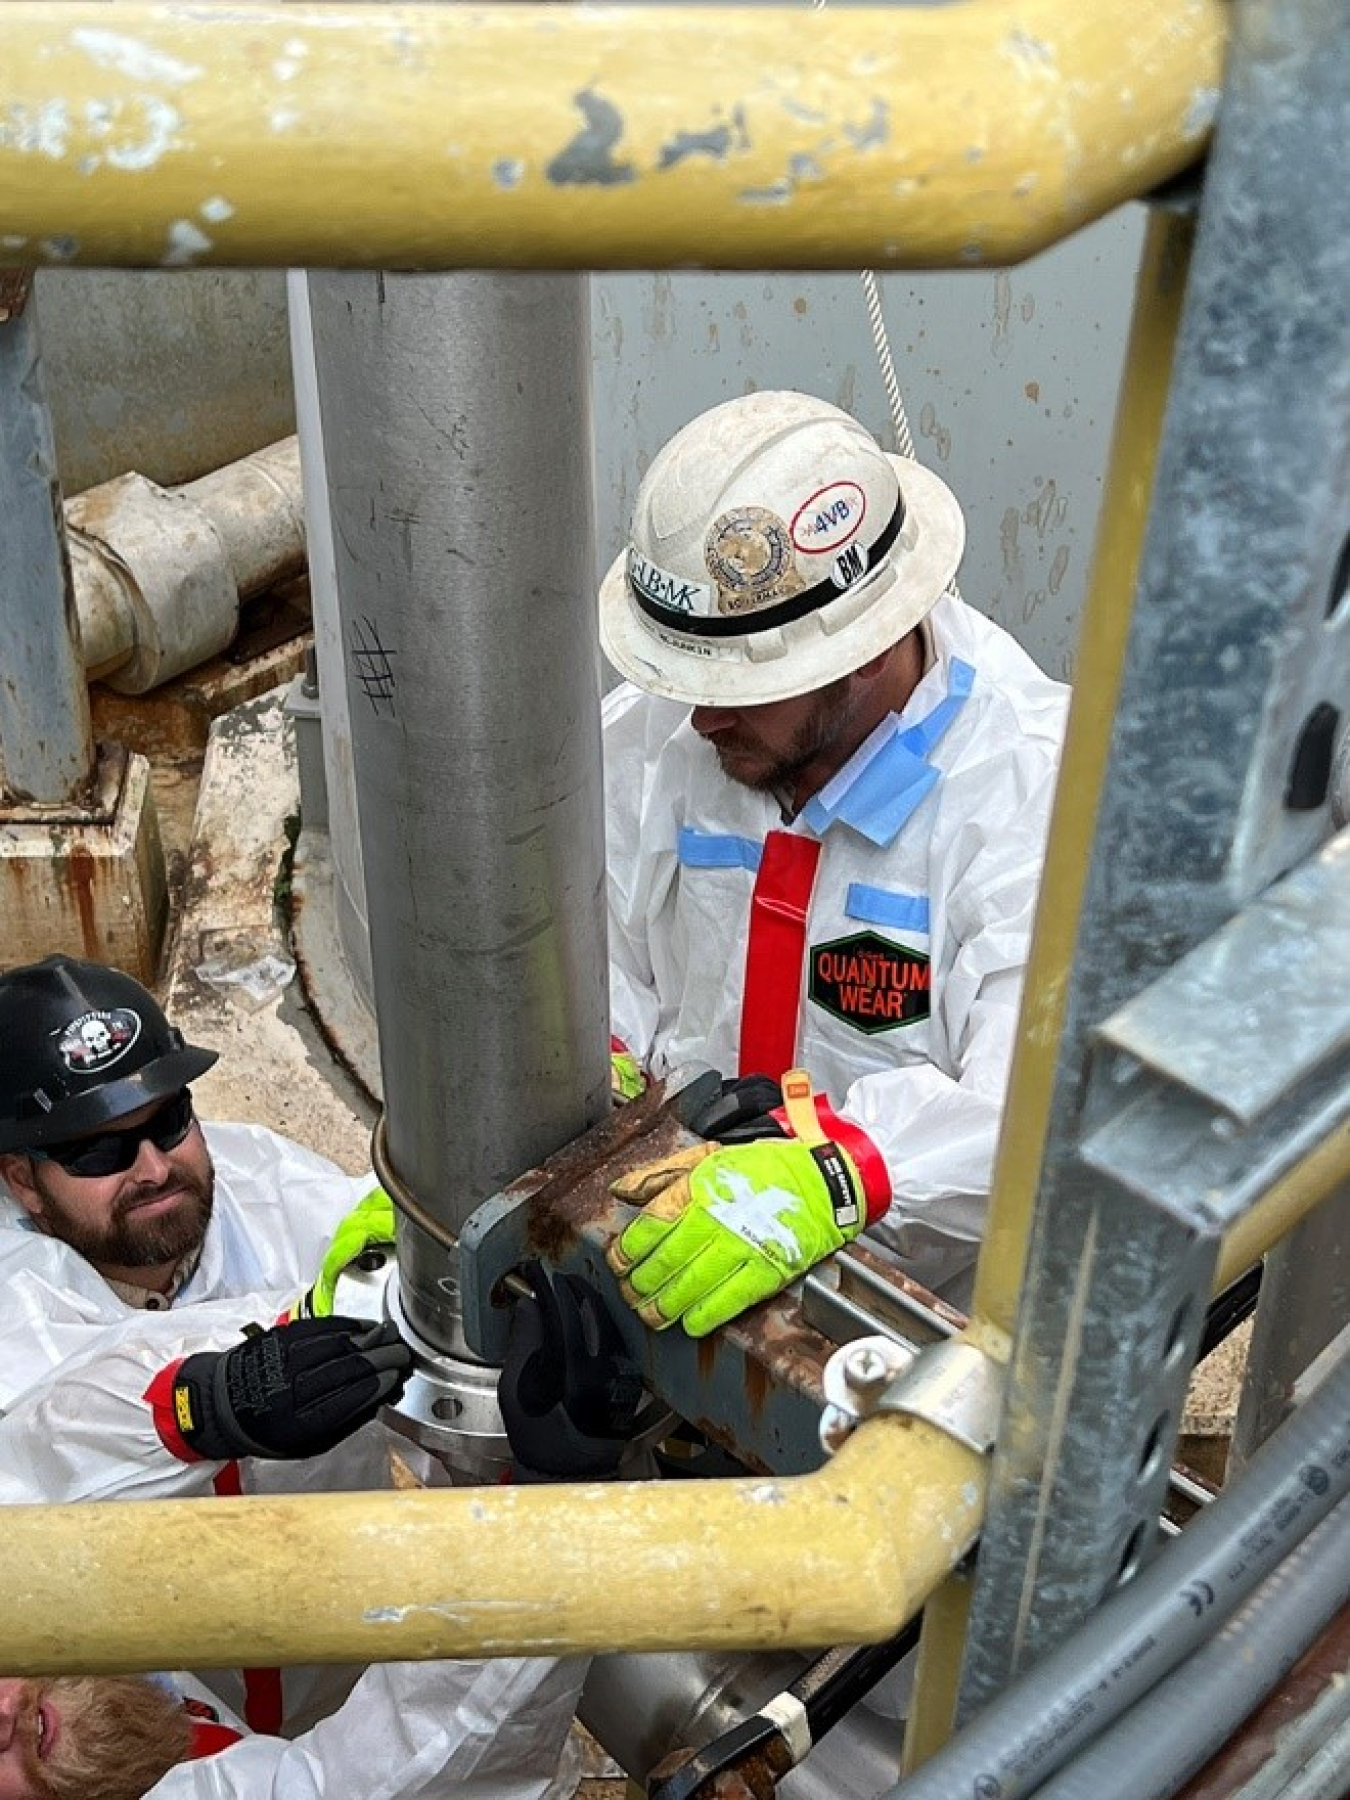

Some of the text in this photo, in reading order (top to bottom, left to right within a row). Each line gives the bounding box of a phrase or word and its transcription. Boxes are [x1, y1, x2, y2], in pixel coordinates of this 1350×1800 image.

[836, 544, 864, 584] BM
[818, 952, 930, 991] QUANTUM
[839, 985, 903, 1019] WEAR
